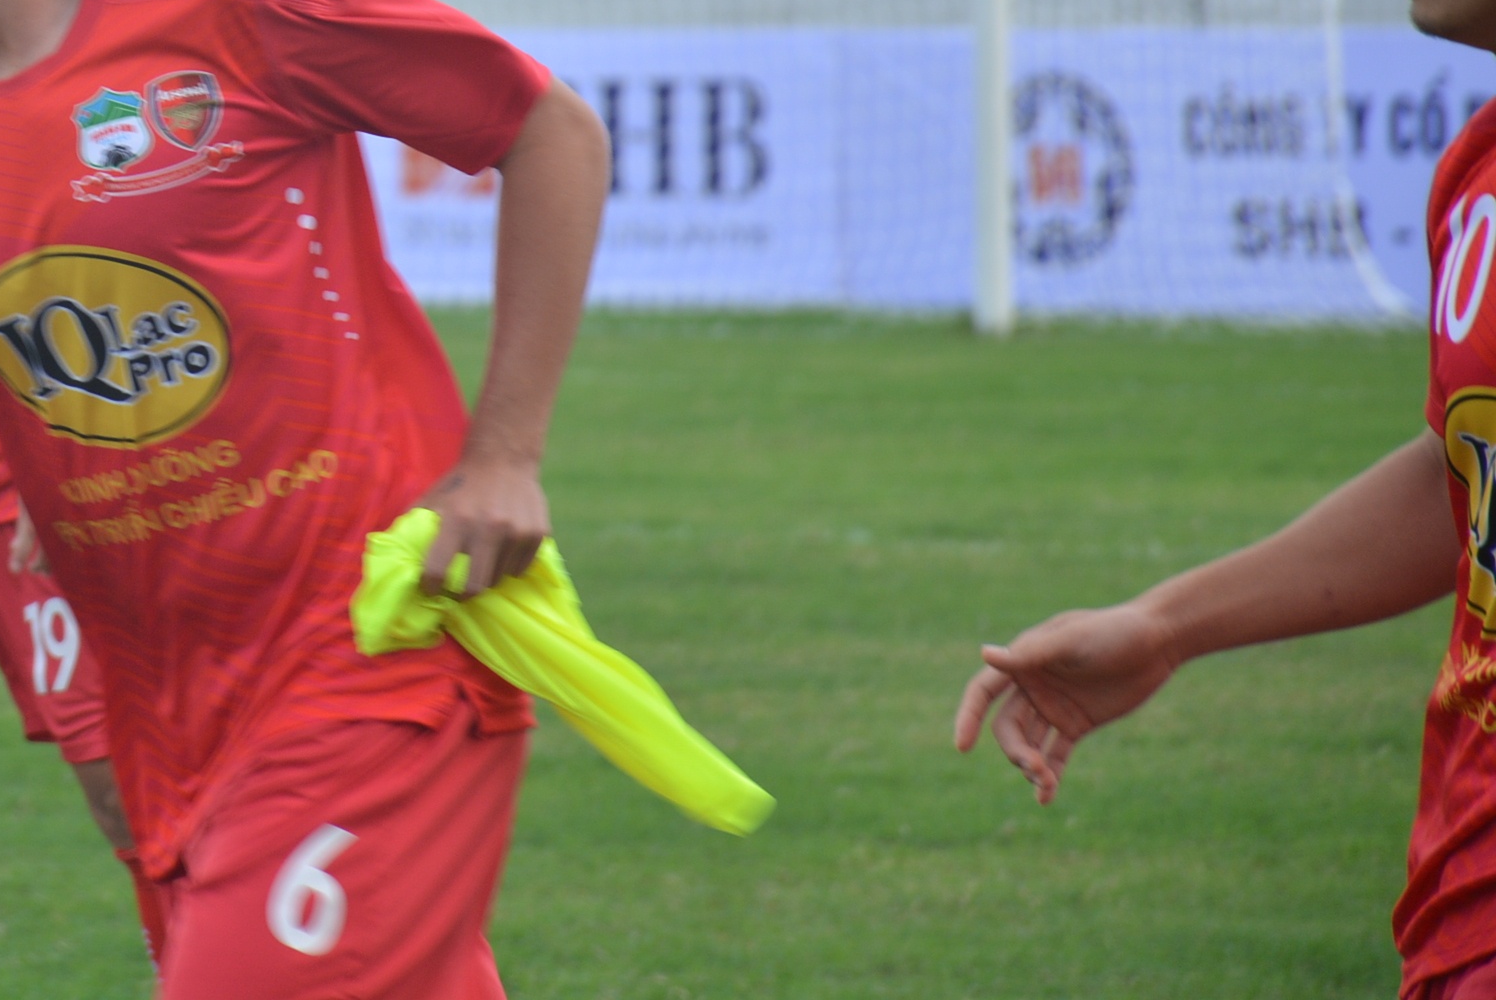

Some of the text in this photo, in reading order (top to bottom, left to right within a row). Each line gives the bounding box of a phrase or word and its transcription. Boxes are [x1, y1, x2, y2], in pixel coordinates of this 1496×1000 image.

[562, 75, 770, 196] HB
[1436, 192, 1496, 343] 10
[23, 596, 81, 695] 19
[265, 822, 359, 956] 6
